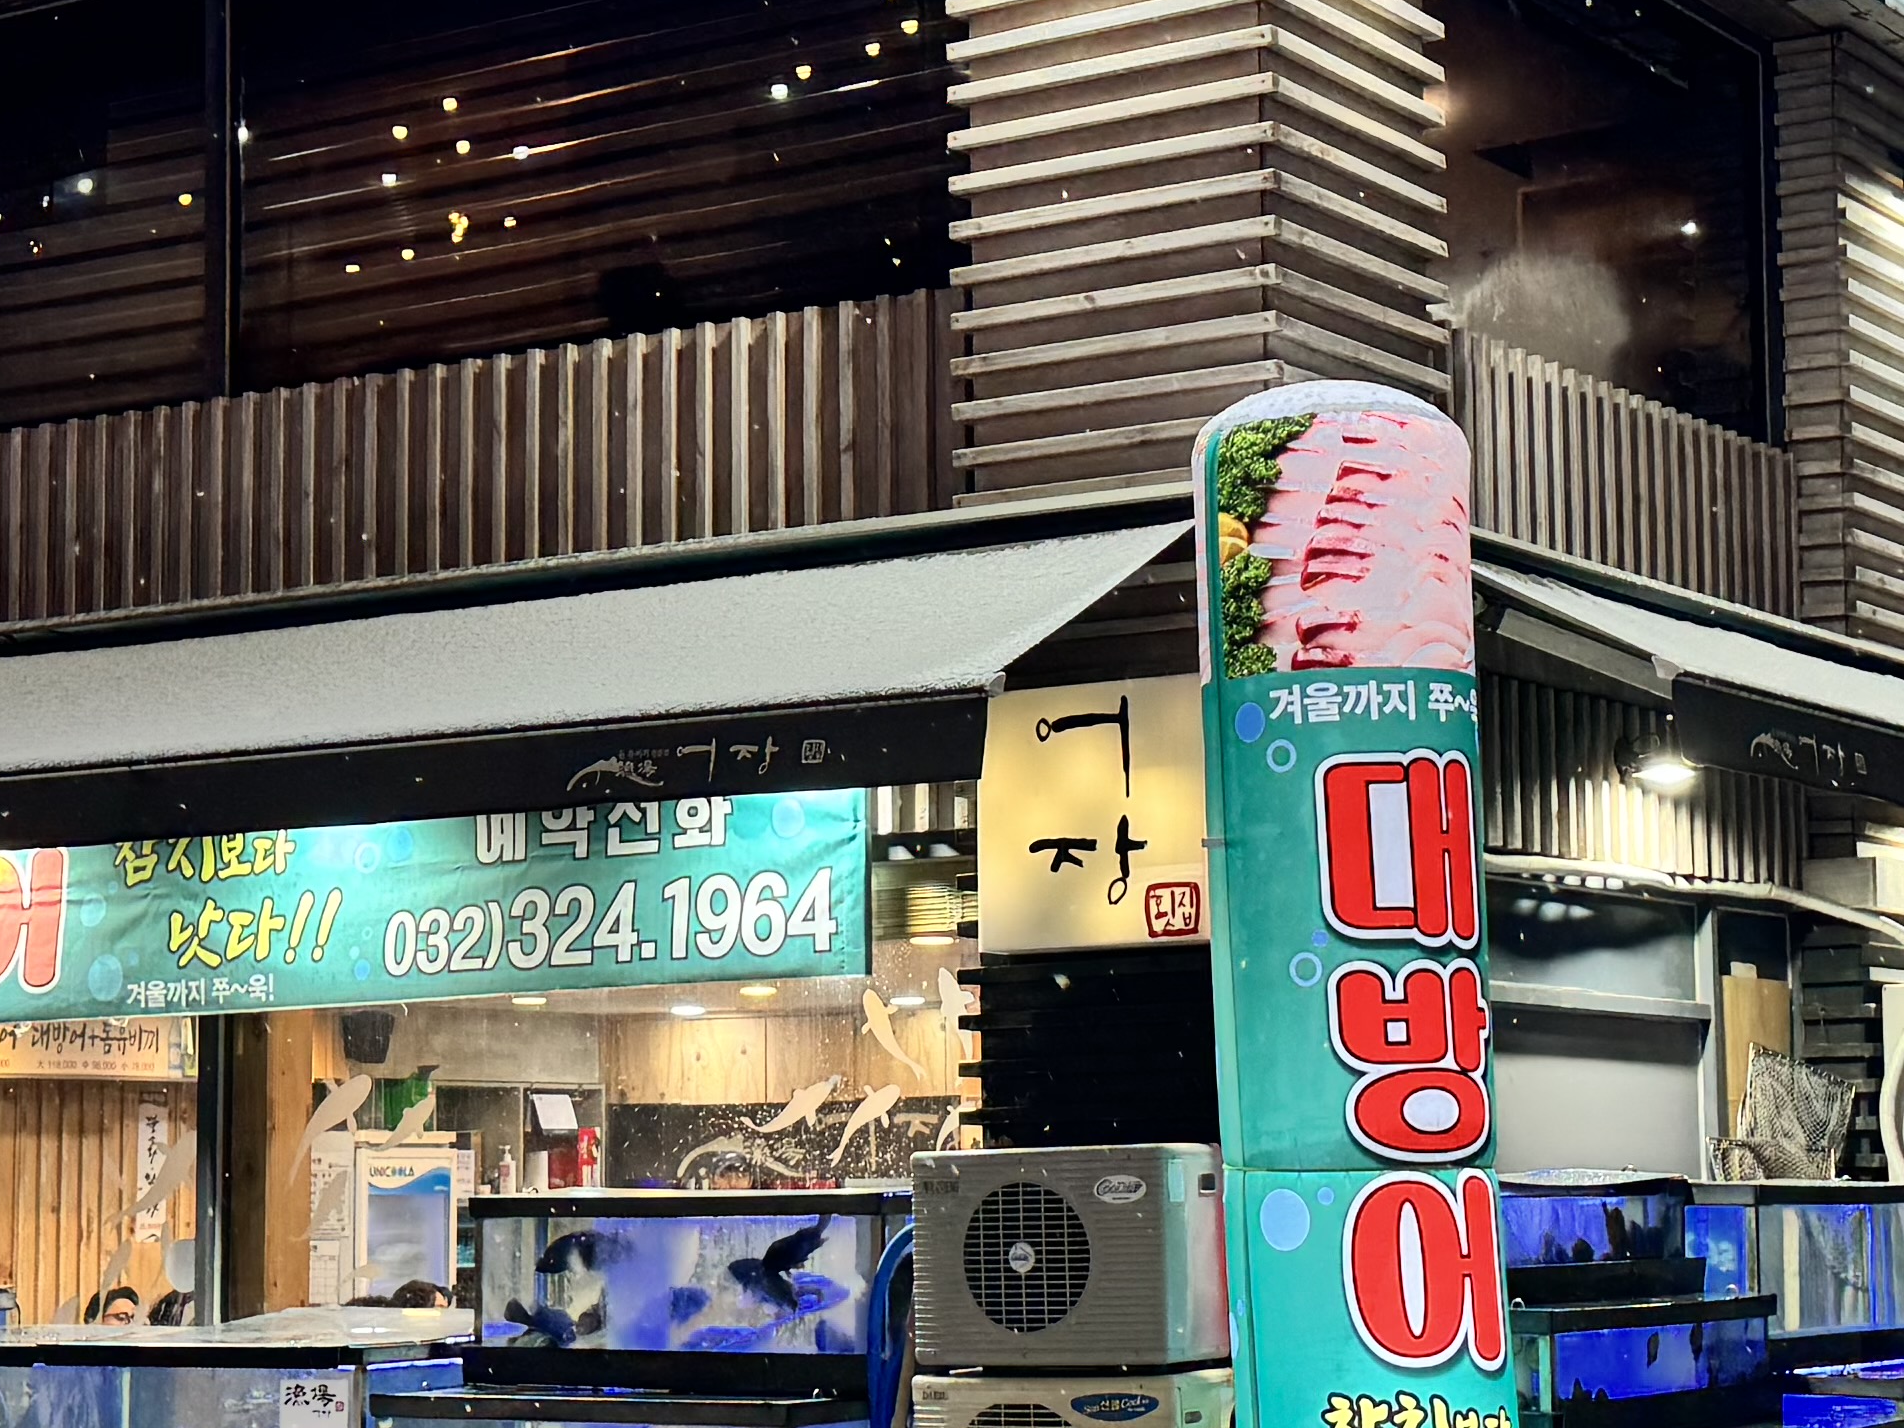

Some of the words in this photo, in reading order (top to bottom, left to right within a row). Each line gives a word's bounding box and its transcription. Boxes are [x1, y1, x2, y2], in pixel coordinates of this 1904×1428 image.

[1269, 680, 1416, 725] 겨울까지
[169, 888, 343, 969] 낫다!!
[383, 866, 838, 975] 032)324.1964
[127, 978, 206, 1009] 겨울까지
[1318, 751, 1506, 1369] 대방어
